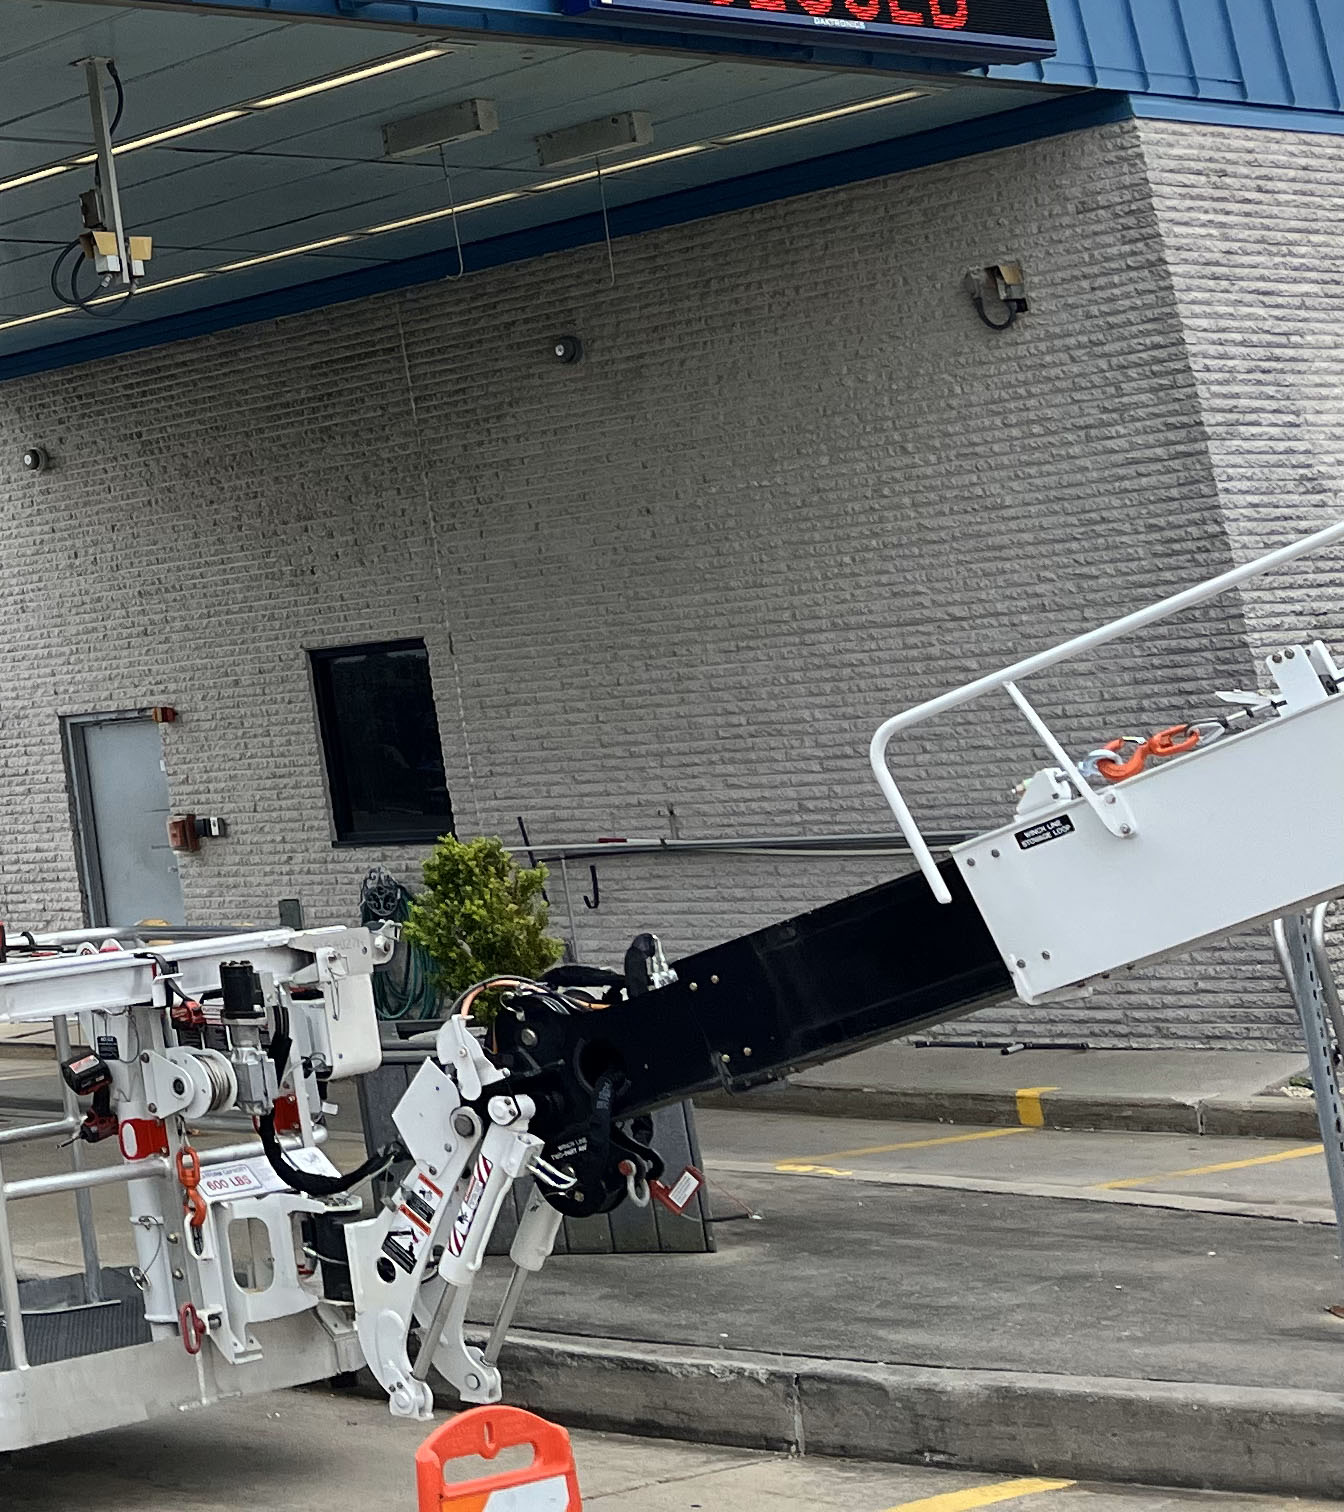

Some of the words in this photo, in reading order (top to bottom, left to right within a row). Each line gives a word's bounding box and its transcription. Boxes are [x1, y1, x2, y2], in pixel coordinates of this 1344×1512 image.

[813, 17, 866, 29] DAKTRONICS
[206, 1178, 230, 1191] 600
[228, 1175, 252, 1187] LBS
